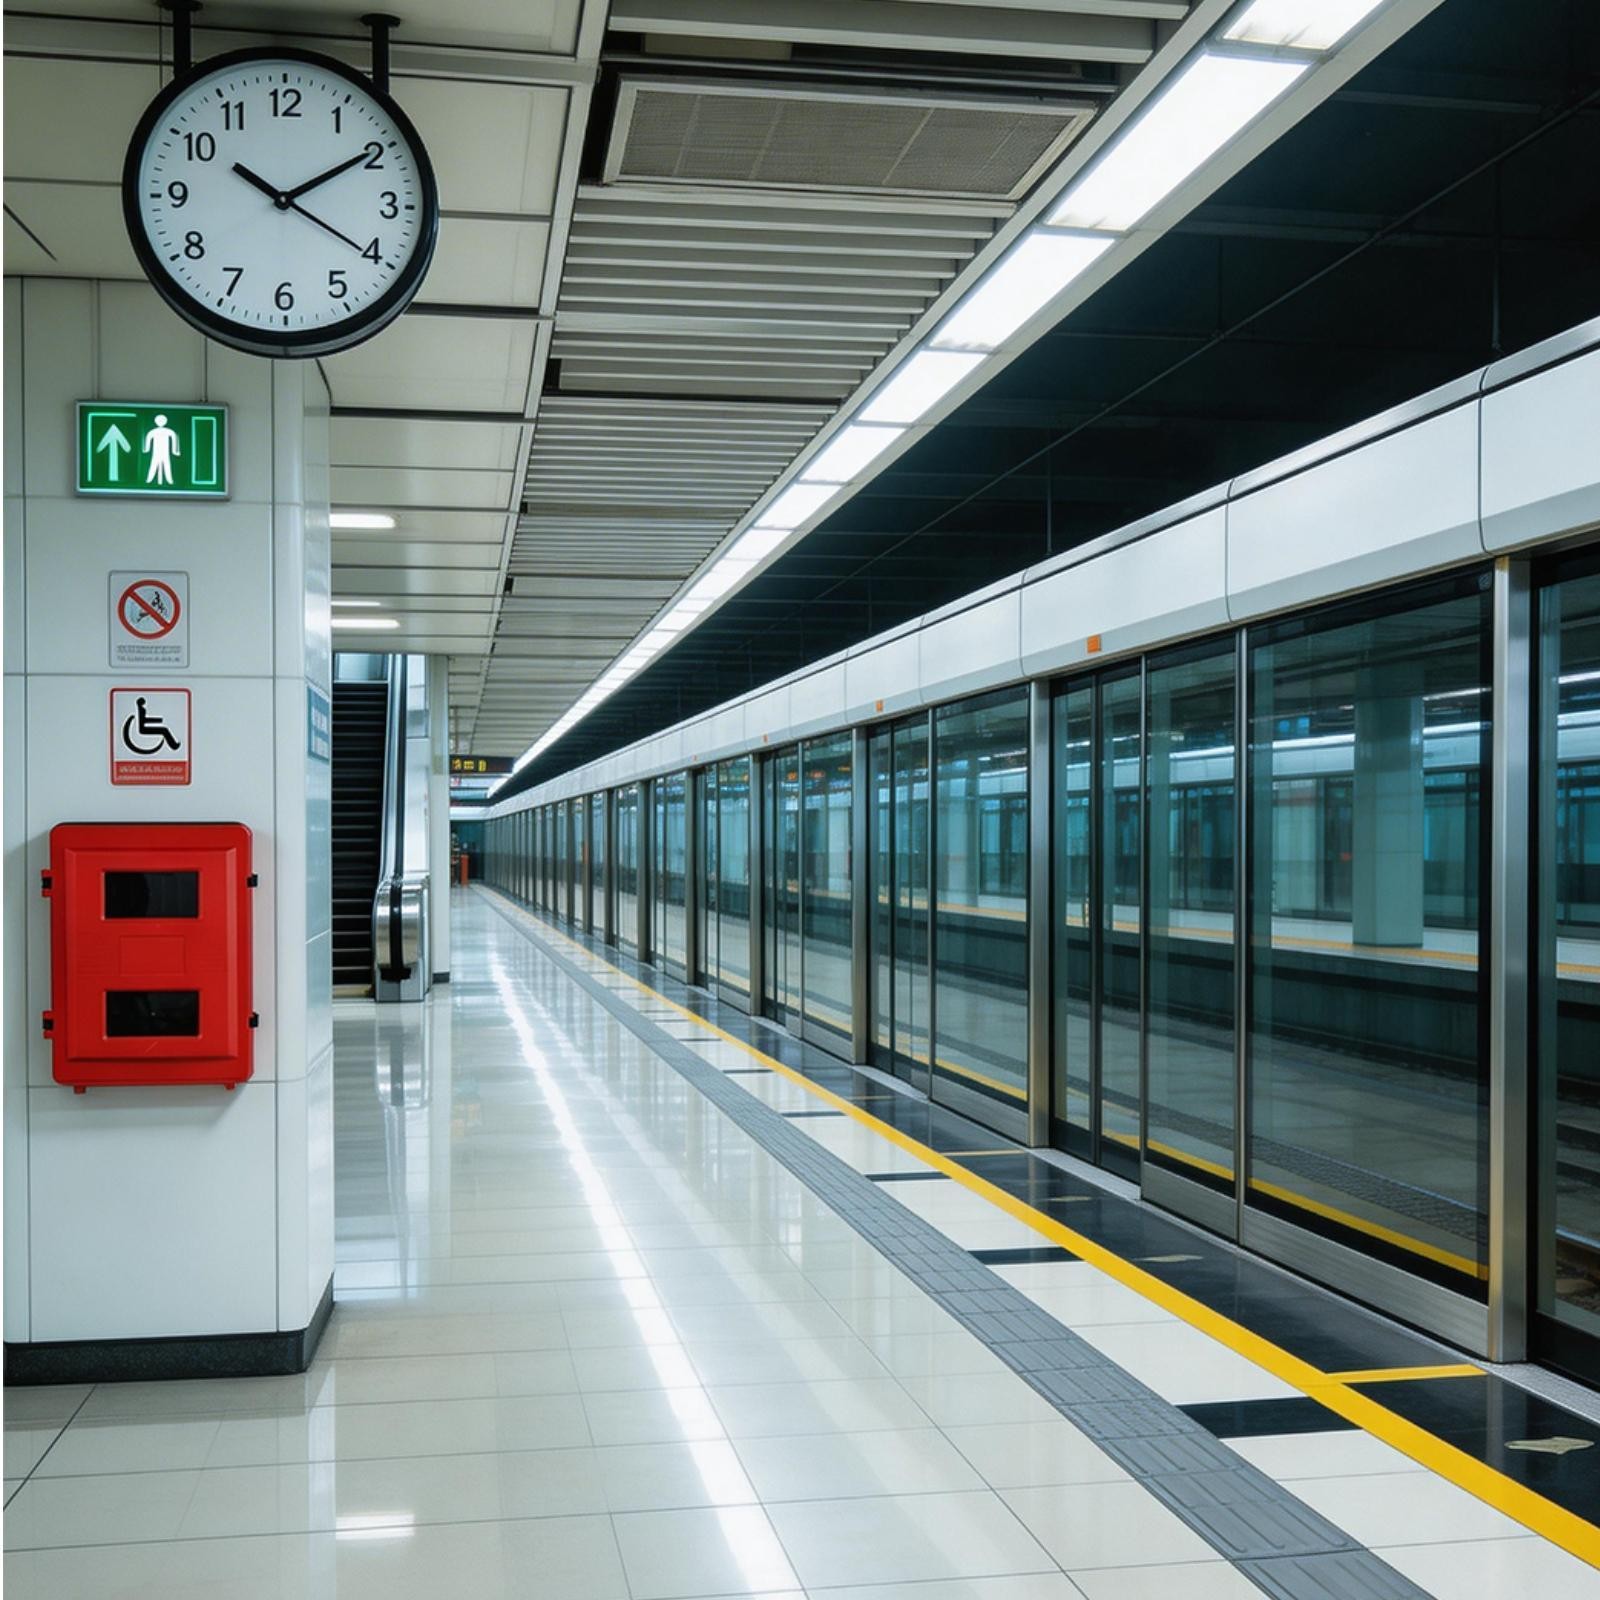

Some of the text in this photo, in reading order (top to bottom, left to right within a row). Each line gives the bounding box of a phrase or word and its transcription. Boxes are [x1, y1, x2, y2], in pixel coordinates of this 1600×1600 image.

[220, 100, 245, 131] 11
[268, 88, 302, 118] 12
[331, 105, 342, 135] 1
[183, 132, 216, 162] 10
[363, 140, 384, 170] 2
[167, 181, 189, 208] 9
[379, 190, 399, 220] 3
[184, 230, 205, 260] 8
[361, 237, 383, 265] 4
[222, 267, 244, 298] 7
[274, 282, 294, 311] 6
[328, 270, 347, 299] 5
